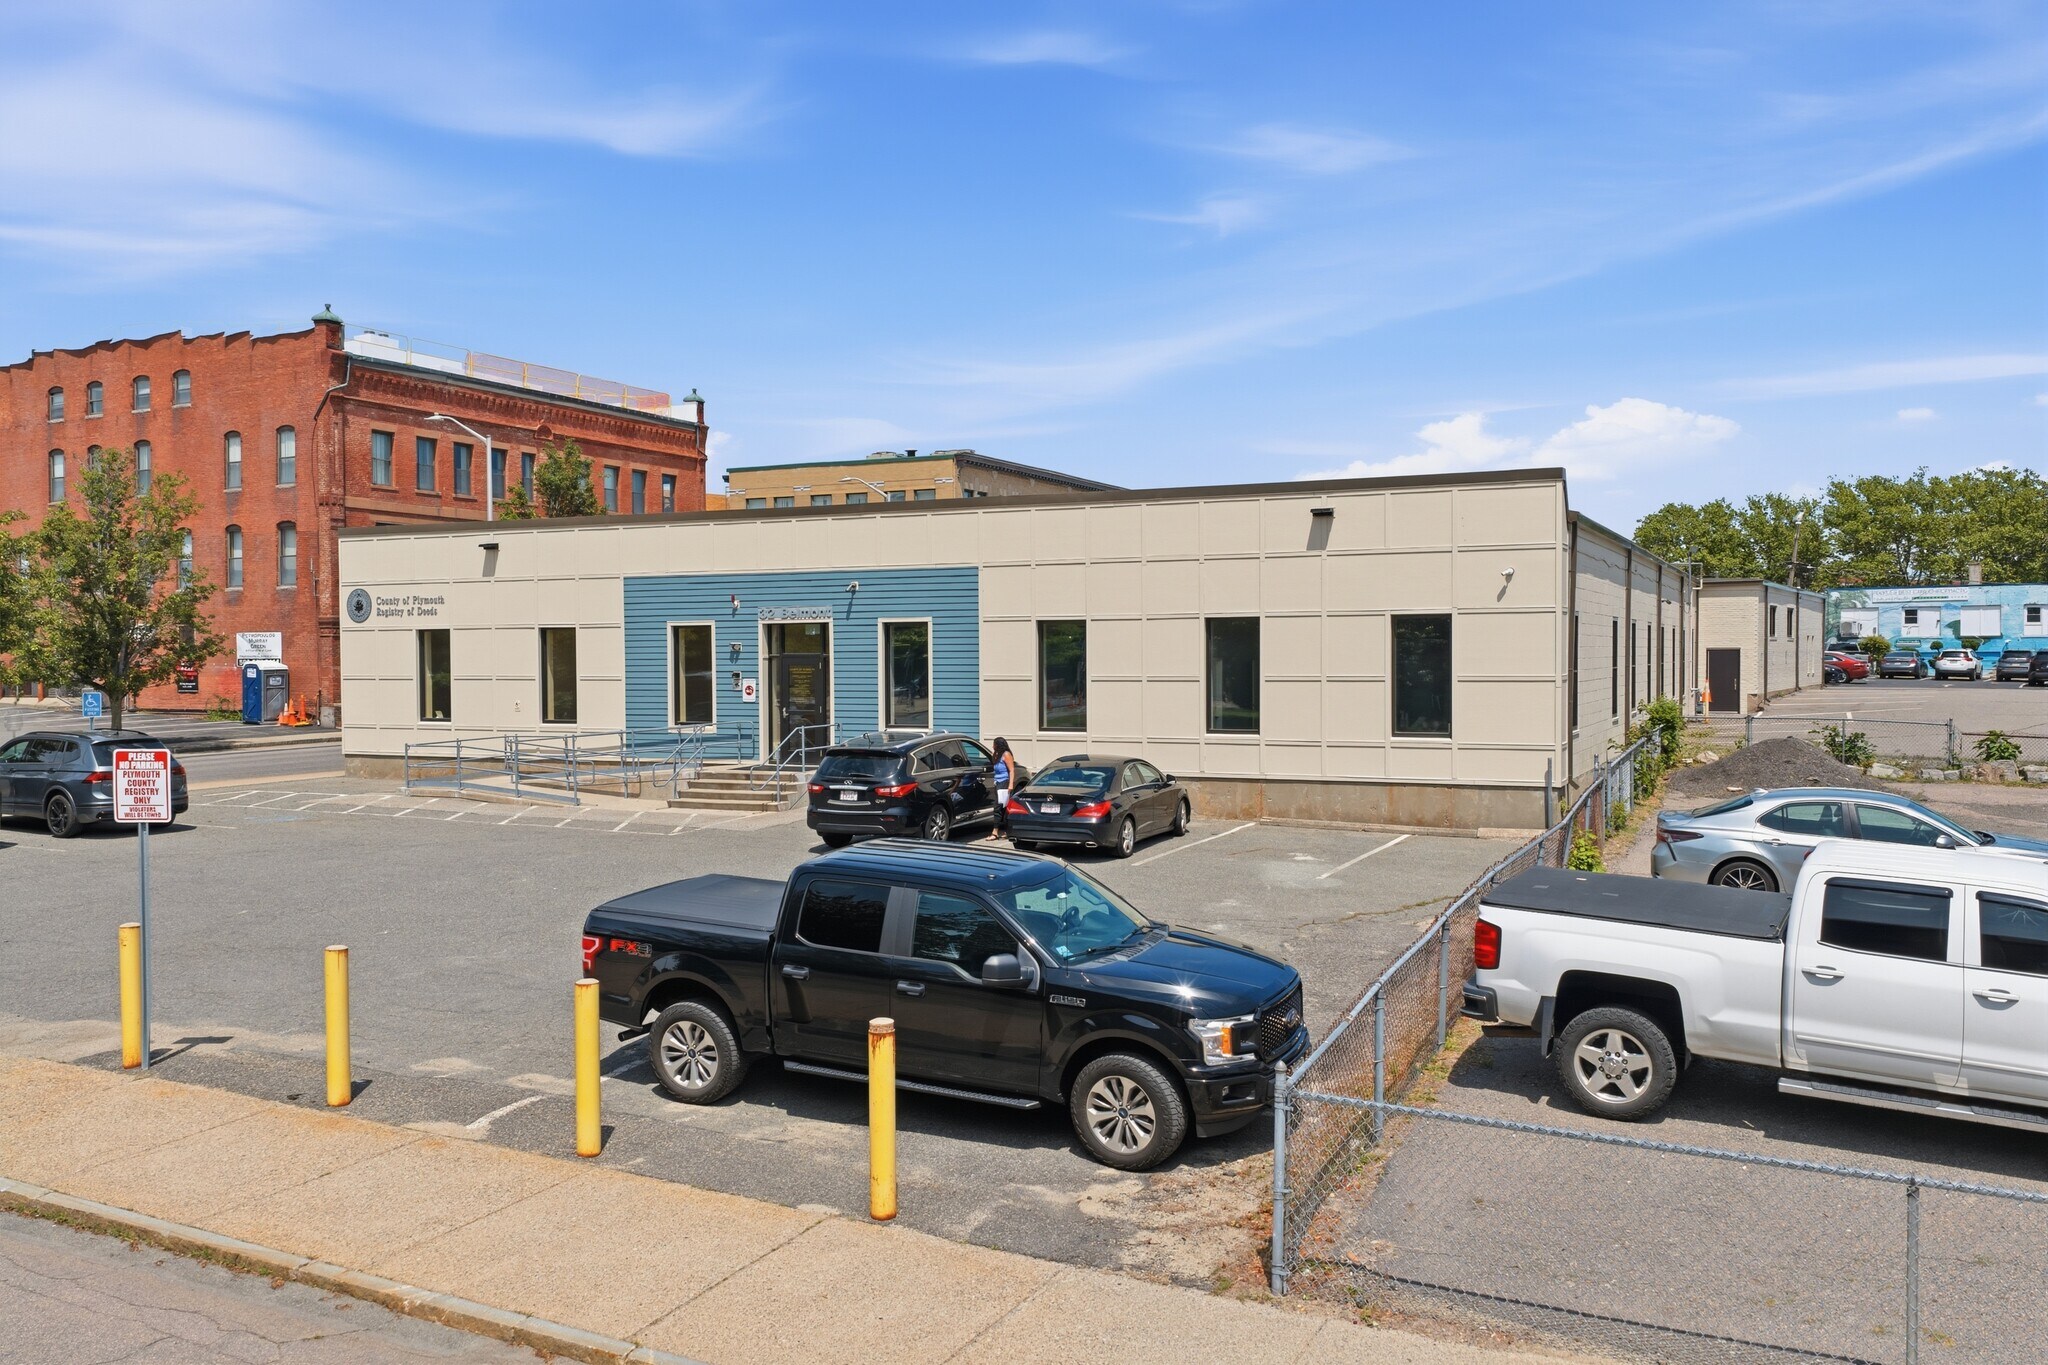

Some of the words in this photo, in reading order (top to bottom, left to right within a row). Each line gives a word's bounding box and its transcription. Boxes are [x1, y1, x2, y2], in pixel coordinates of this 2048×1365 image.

[376, 596, 400, 606] County
[403, 596, 410, 605] of
[412, 595, 445, 606] Plymouth
[376, 607, 404, 618] Registry
[407, 607, 414, 616] of
[417, 606, 438, 616] Deeds
[781, 606, 832, 619] Belmont
[128, 752, 155, 761] PLEASE
[118, 761, 129, 769] NO
[130, 761, 164, 770] PARKING
[122, 770, 160, 778] PLYMOUTH
[127, 779, 156, 787] COUNTY
[124, 787, 160, 796] REGISTRY
[133, 796, 151, 804] ONLY
